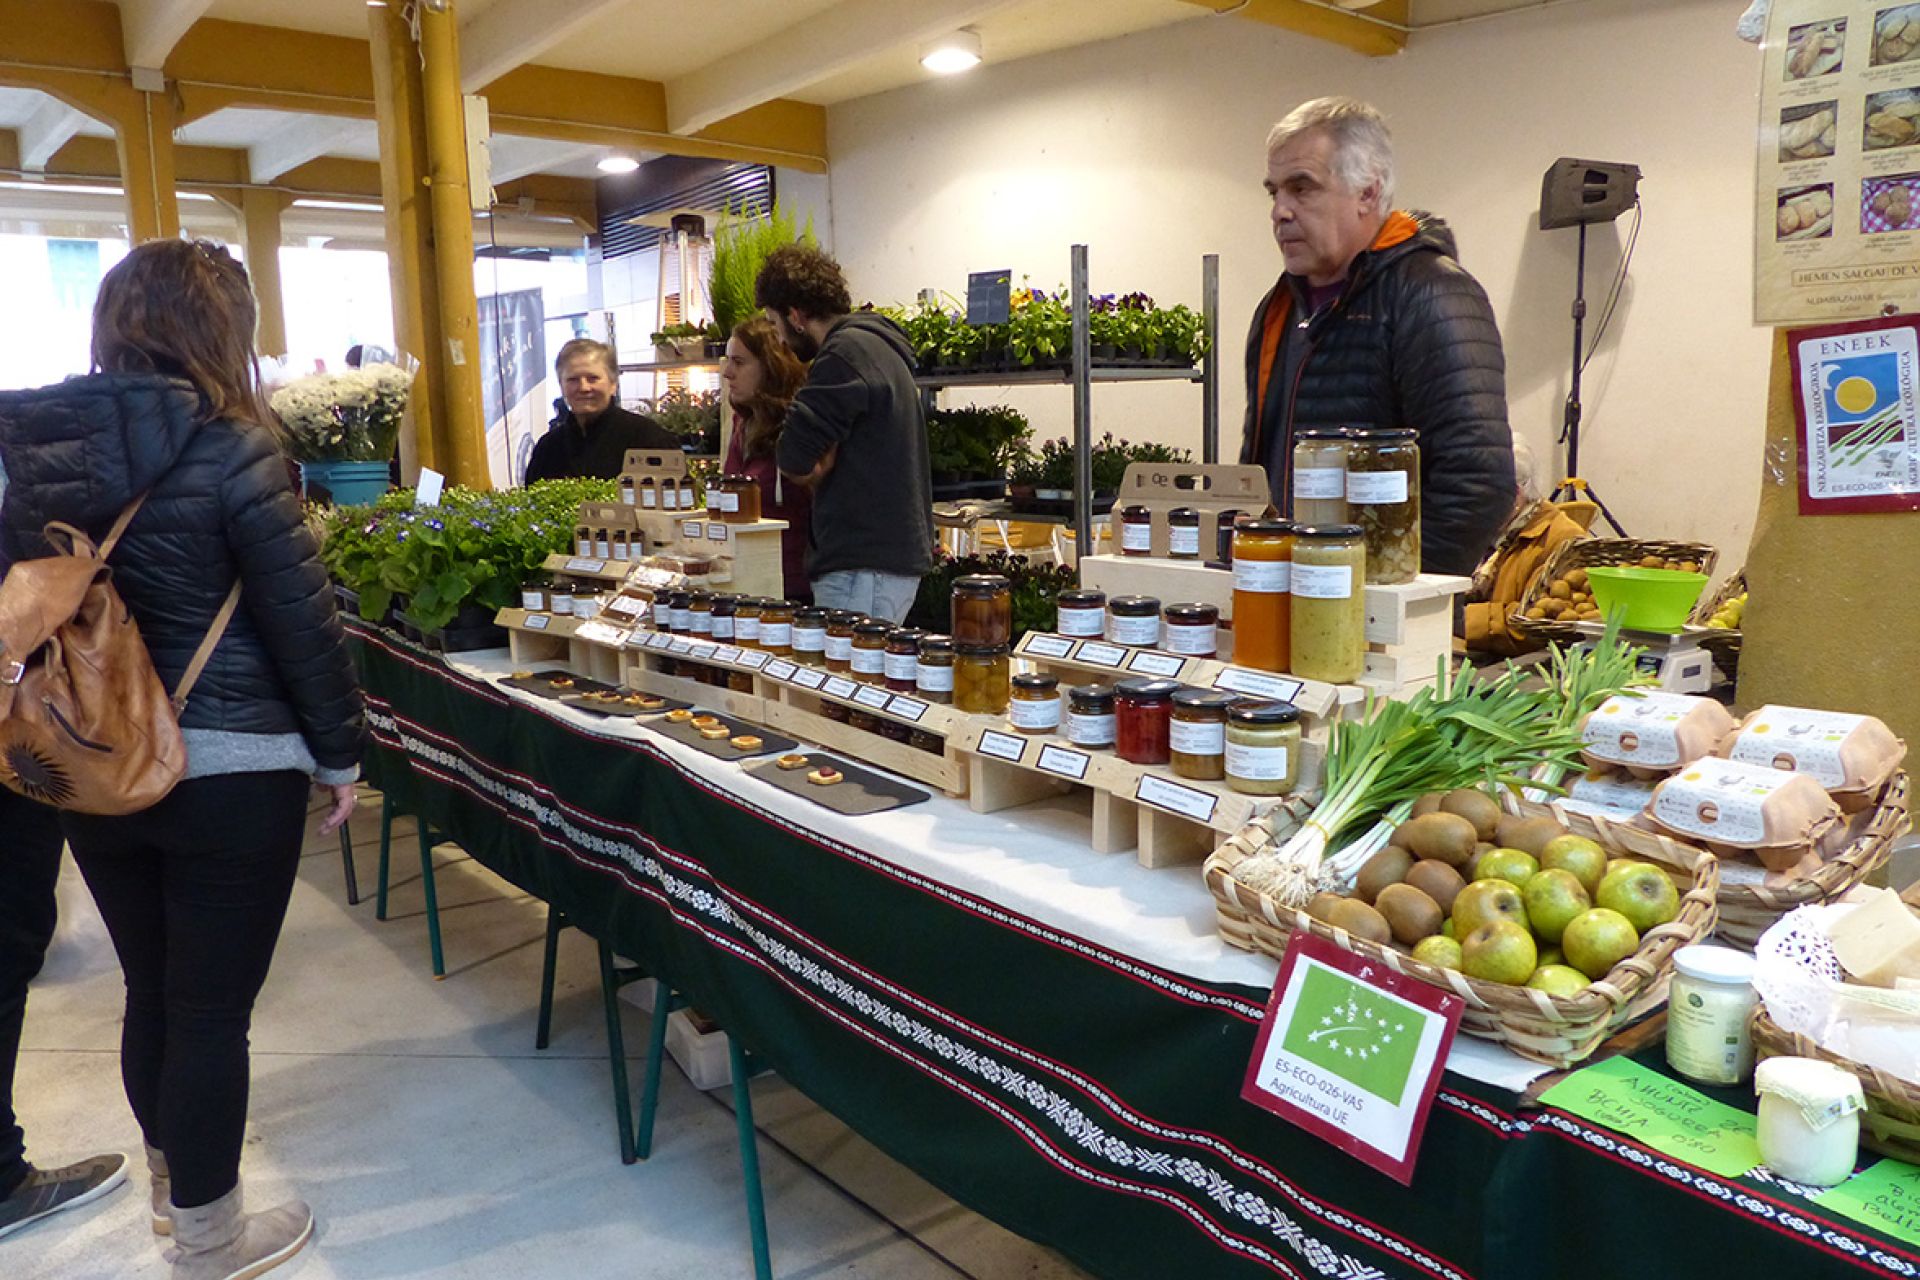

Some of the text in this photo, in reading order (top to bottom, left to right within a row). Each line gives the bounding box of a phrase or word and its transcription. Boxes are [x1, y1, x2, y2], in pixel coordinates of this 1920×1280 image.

[1821, 335, 1891, 355] ENEEK
[1269, 1078, 1350, 1125] Agricultura UE
[1274, 1058, 1364, 1111] ES-ECO-026-VAS
